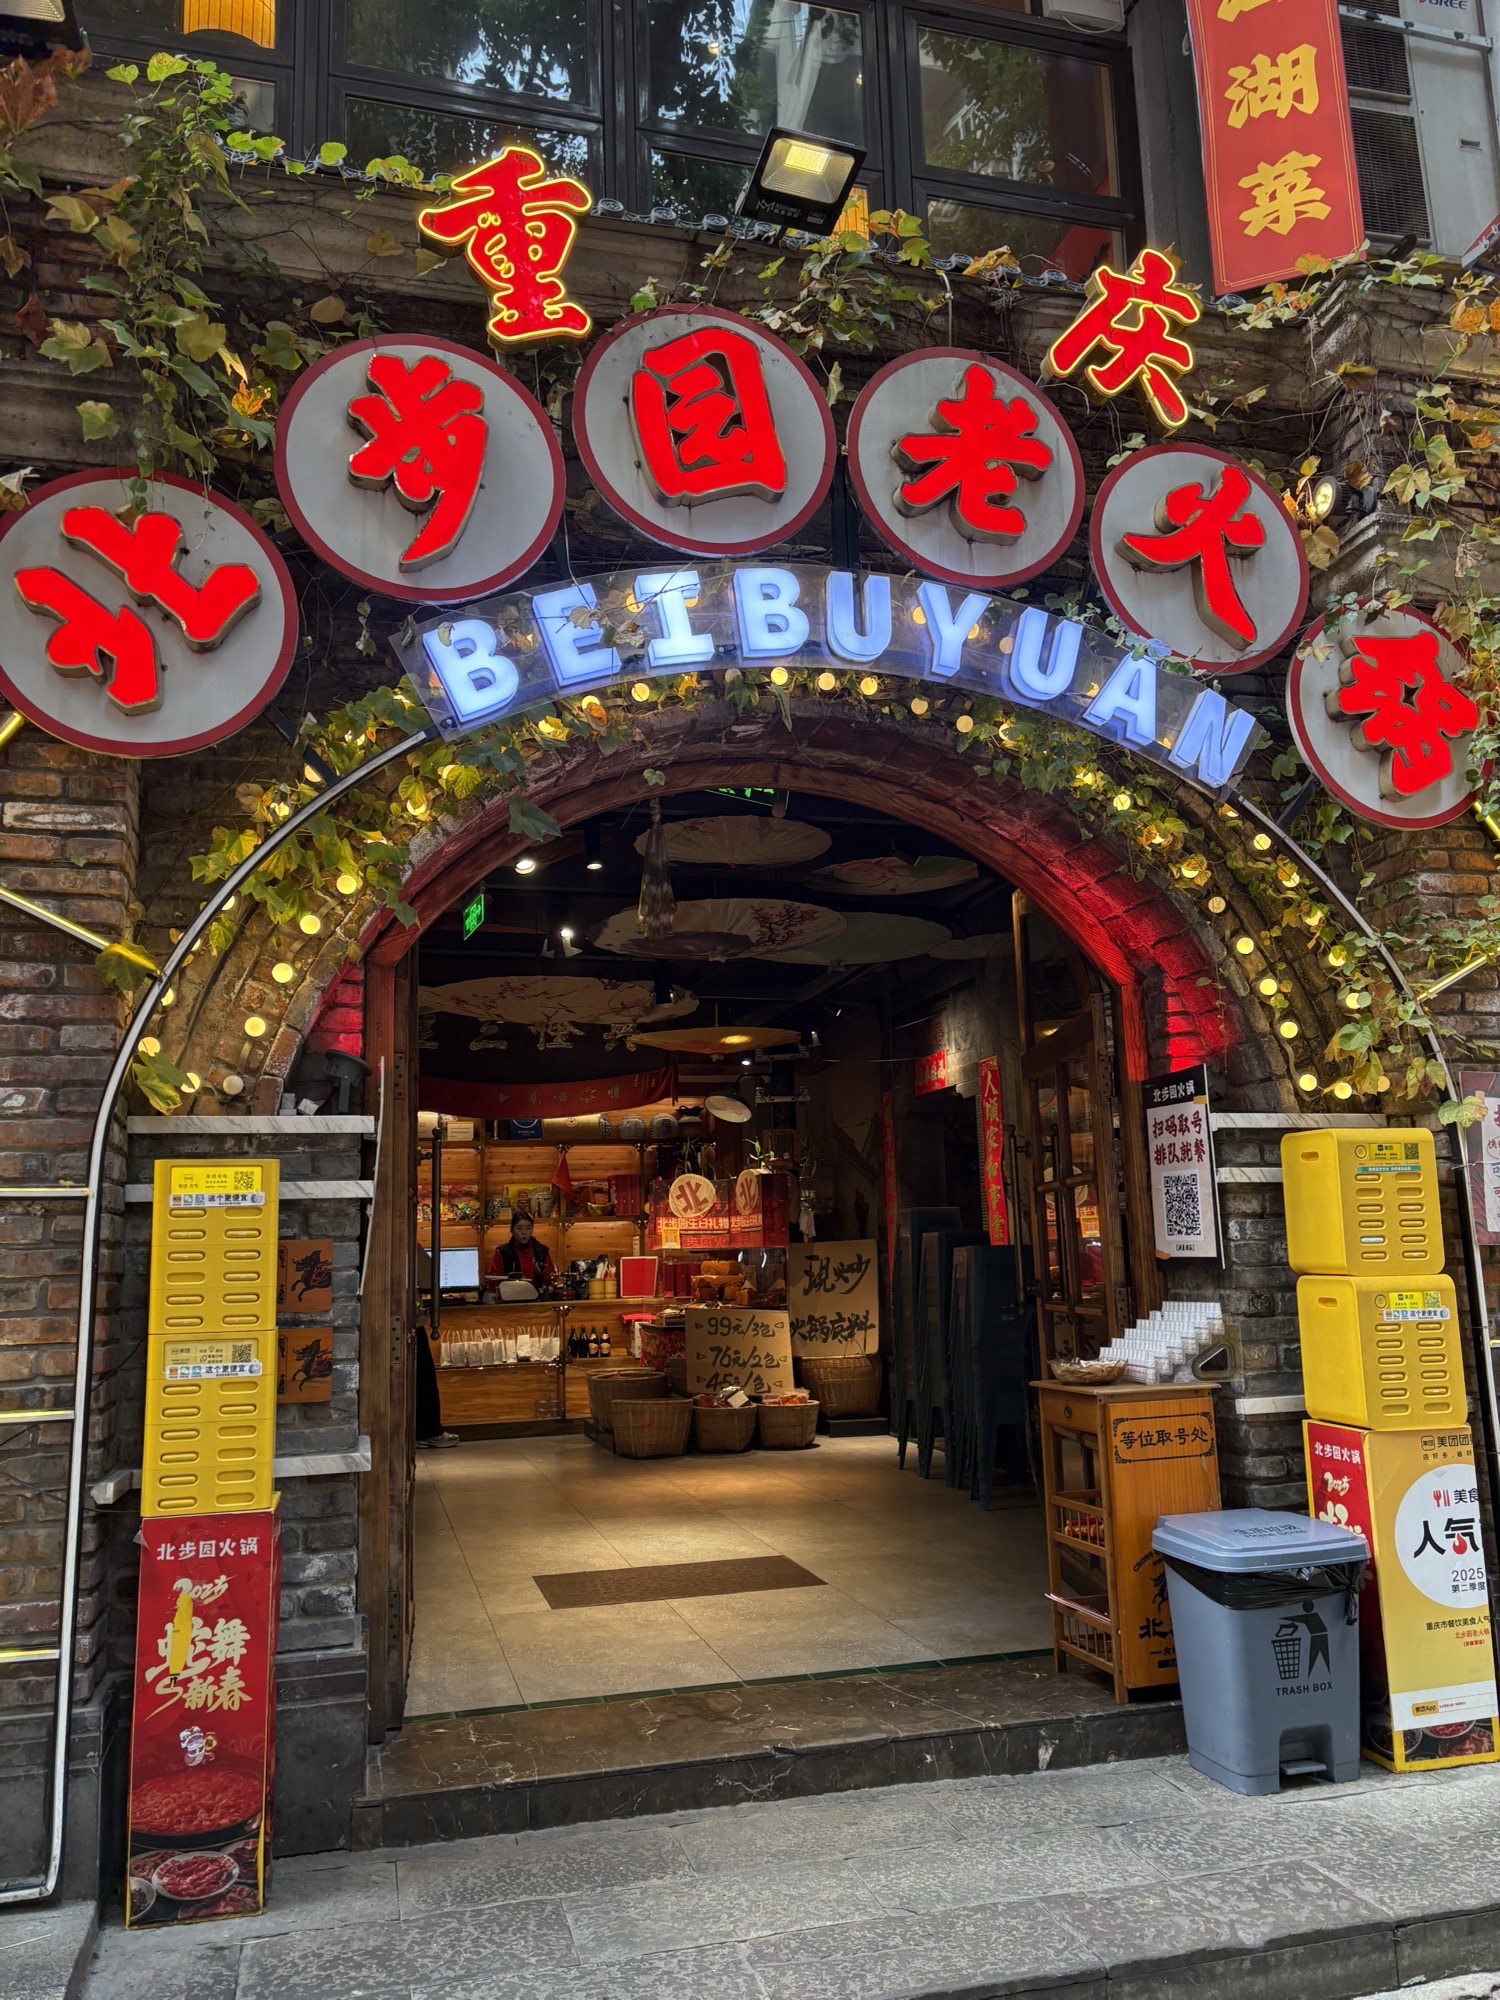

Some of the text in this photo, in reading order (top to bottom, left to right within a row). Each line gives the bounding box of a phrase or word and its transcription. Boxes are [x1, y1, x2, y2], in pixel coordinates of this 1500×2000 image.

[1217, 0, 1332, 237] 湖菜
[422, 568, 1258, 789] BEIBUYUAN
[1153, 1079, 1196, 1103] 北步园火锅
[1152, 1110, 1203, 1139] 扫码取号
[1154, 1137, 1207, 1166] 排队就餐
[207, 1194, 248, 1203] 这个更便宜
[675, 1181, 709, 1214] 北
[205, 1364, 246, 1374] 这个更便宜
[1120, 1426, 1209, 1450] 等位取号处
[1437, 1435, 1473, 1448] 美团团
[1314, 1441, 1361, 1465] 北步园火锅
[156, 1538, 259, 1562] 北步园火锅
[1451, 1567, 1484, 1583] 2025
[1451, 1581, 1487, 1594] 第二季度
[1276, 1680, 1333, 1697] TRASH BOX
